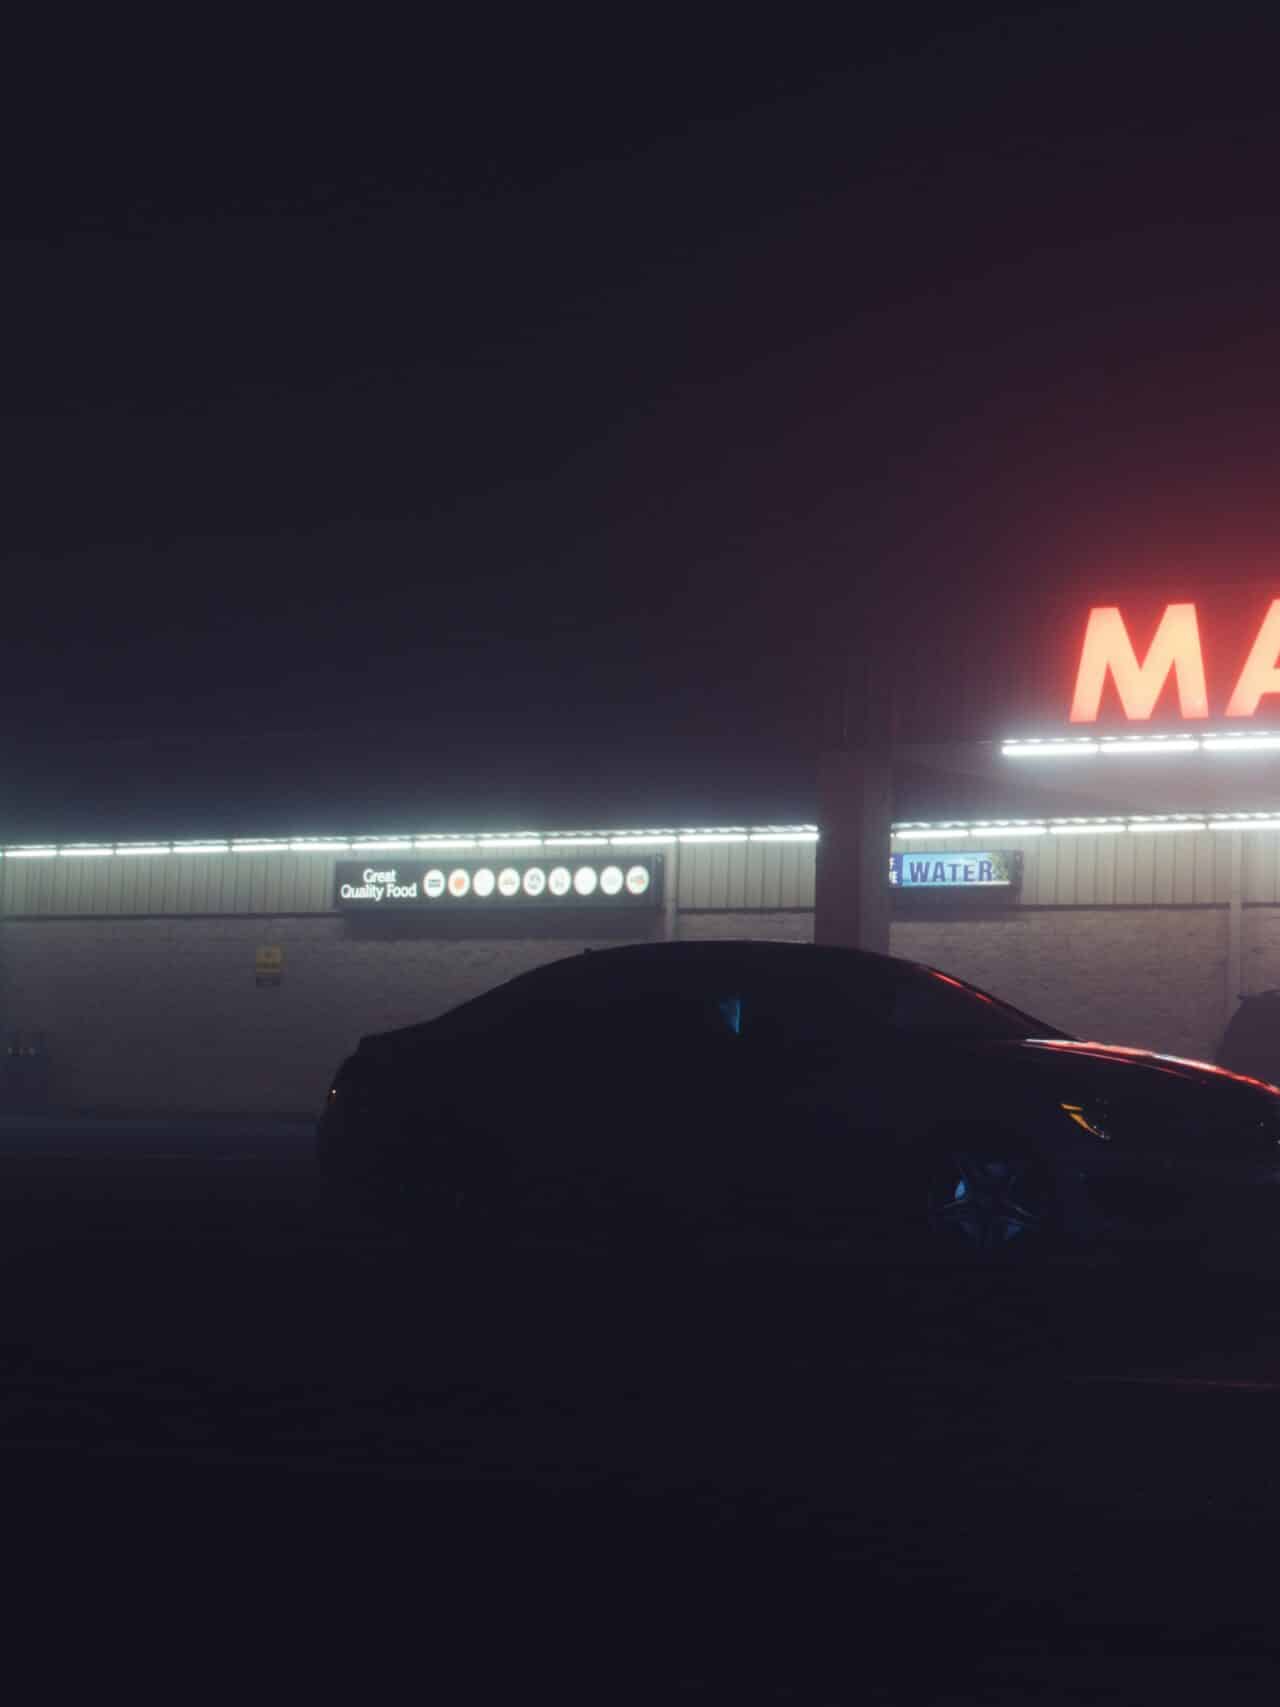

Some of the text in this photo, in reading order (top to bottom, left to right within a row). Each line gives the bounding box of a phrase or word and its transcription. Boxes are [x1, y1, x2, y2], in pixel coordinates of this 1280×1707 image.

[362, 868, 397, 883] Great
[909, 860, 993, 882] WATER
[340, 883, 385, 901] Quality
[386, 882, 418, 898] Food
